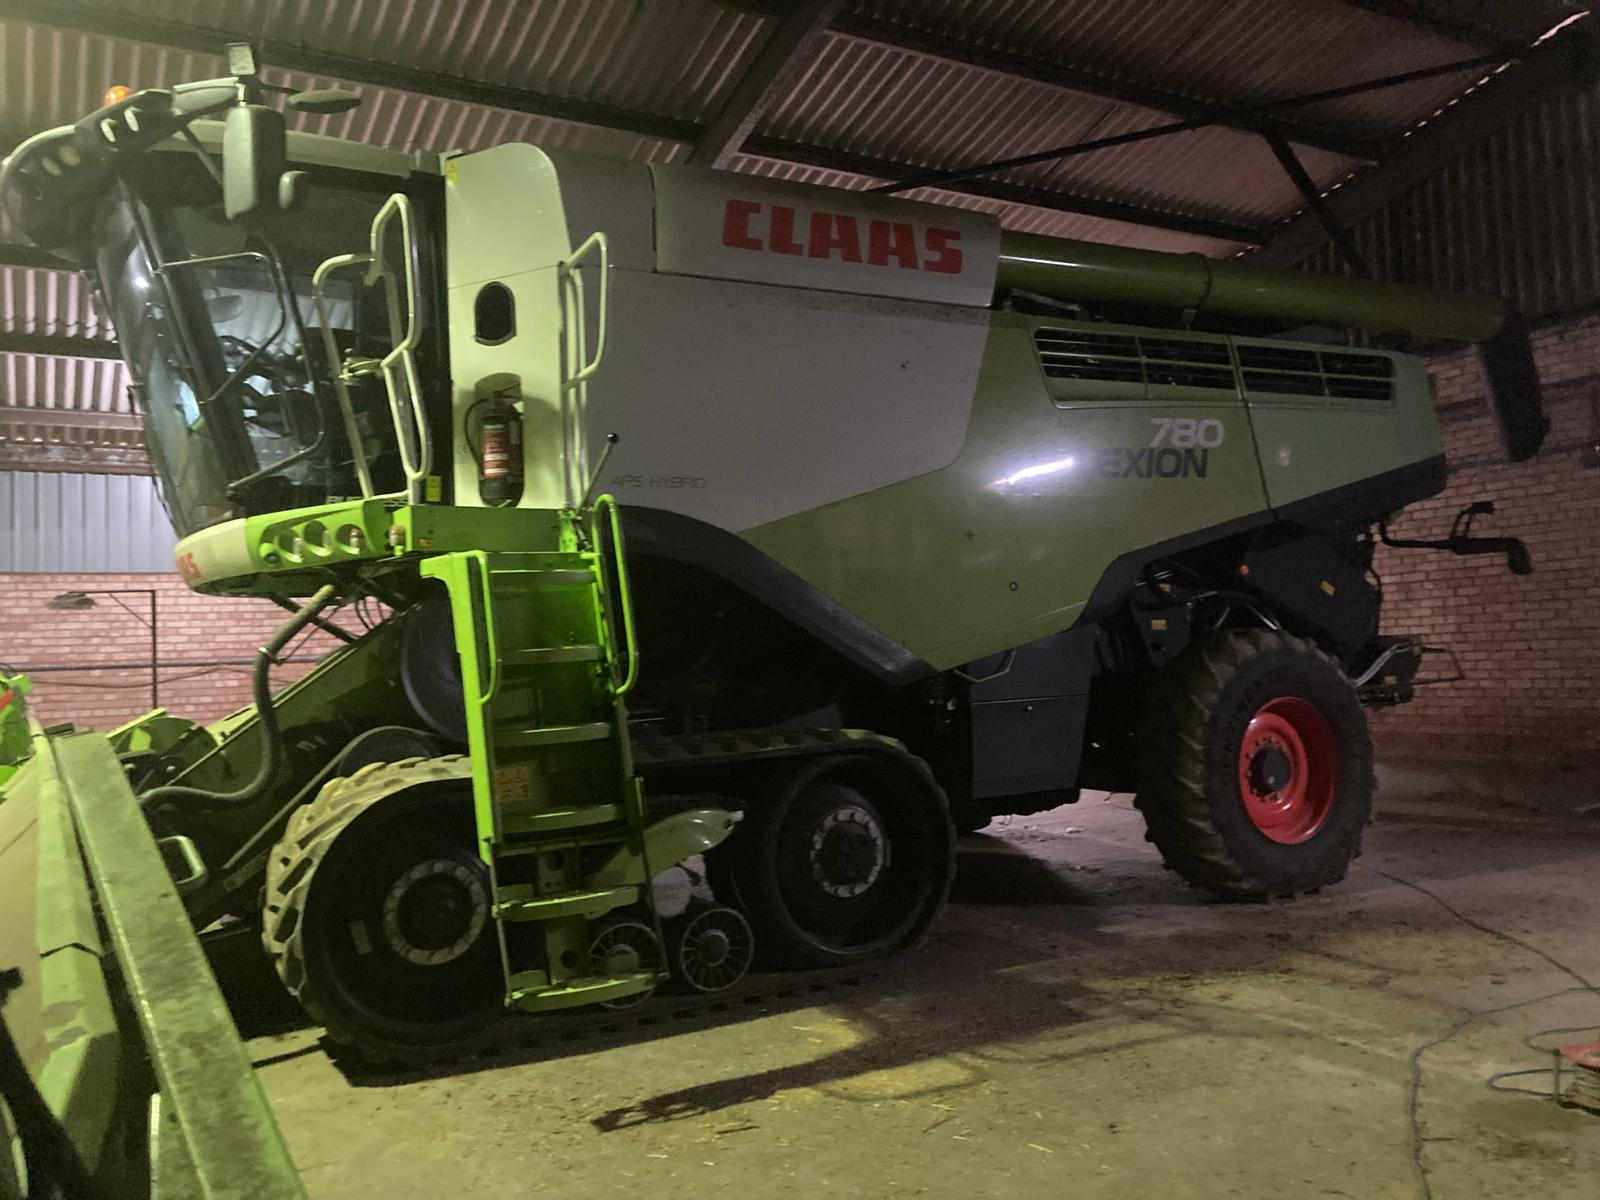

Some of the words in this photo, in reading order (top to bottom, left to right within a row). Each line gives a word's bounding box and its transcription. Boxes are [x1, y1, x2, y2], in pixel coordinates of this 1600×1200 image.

[722, 199, 963, 274] CLAAS
[1150, 417, 1225, 449] 780
[1096, 447, 1209, 478] EXION
